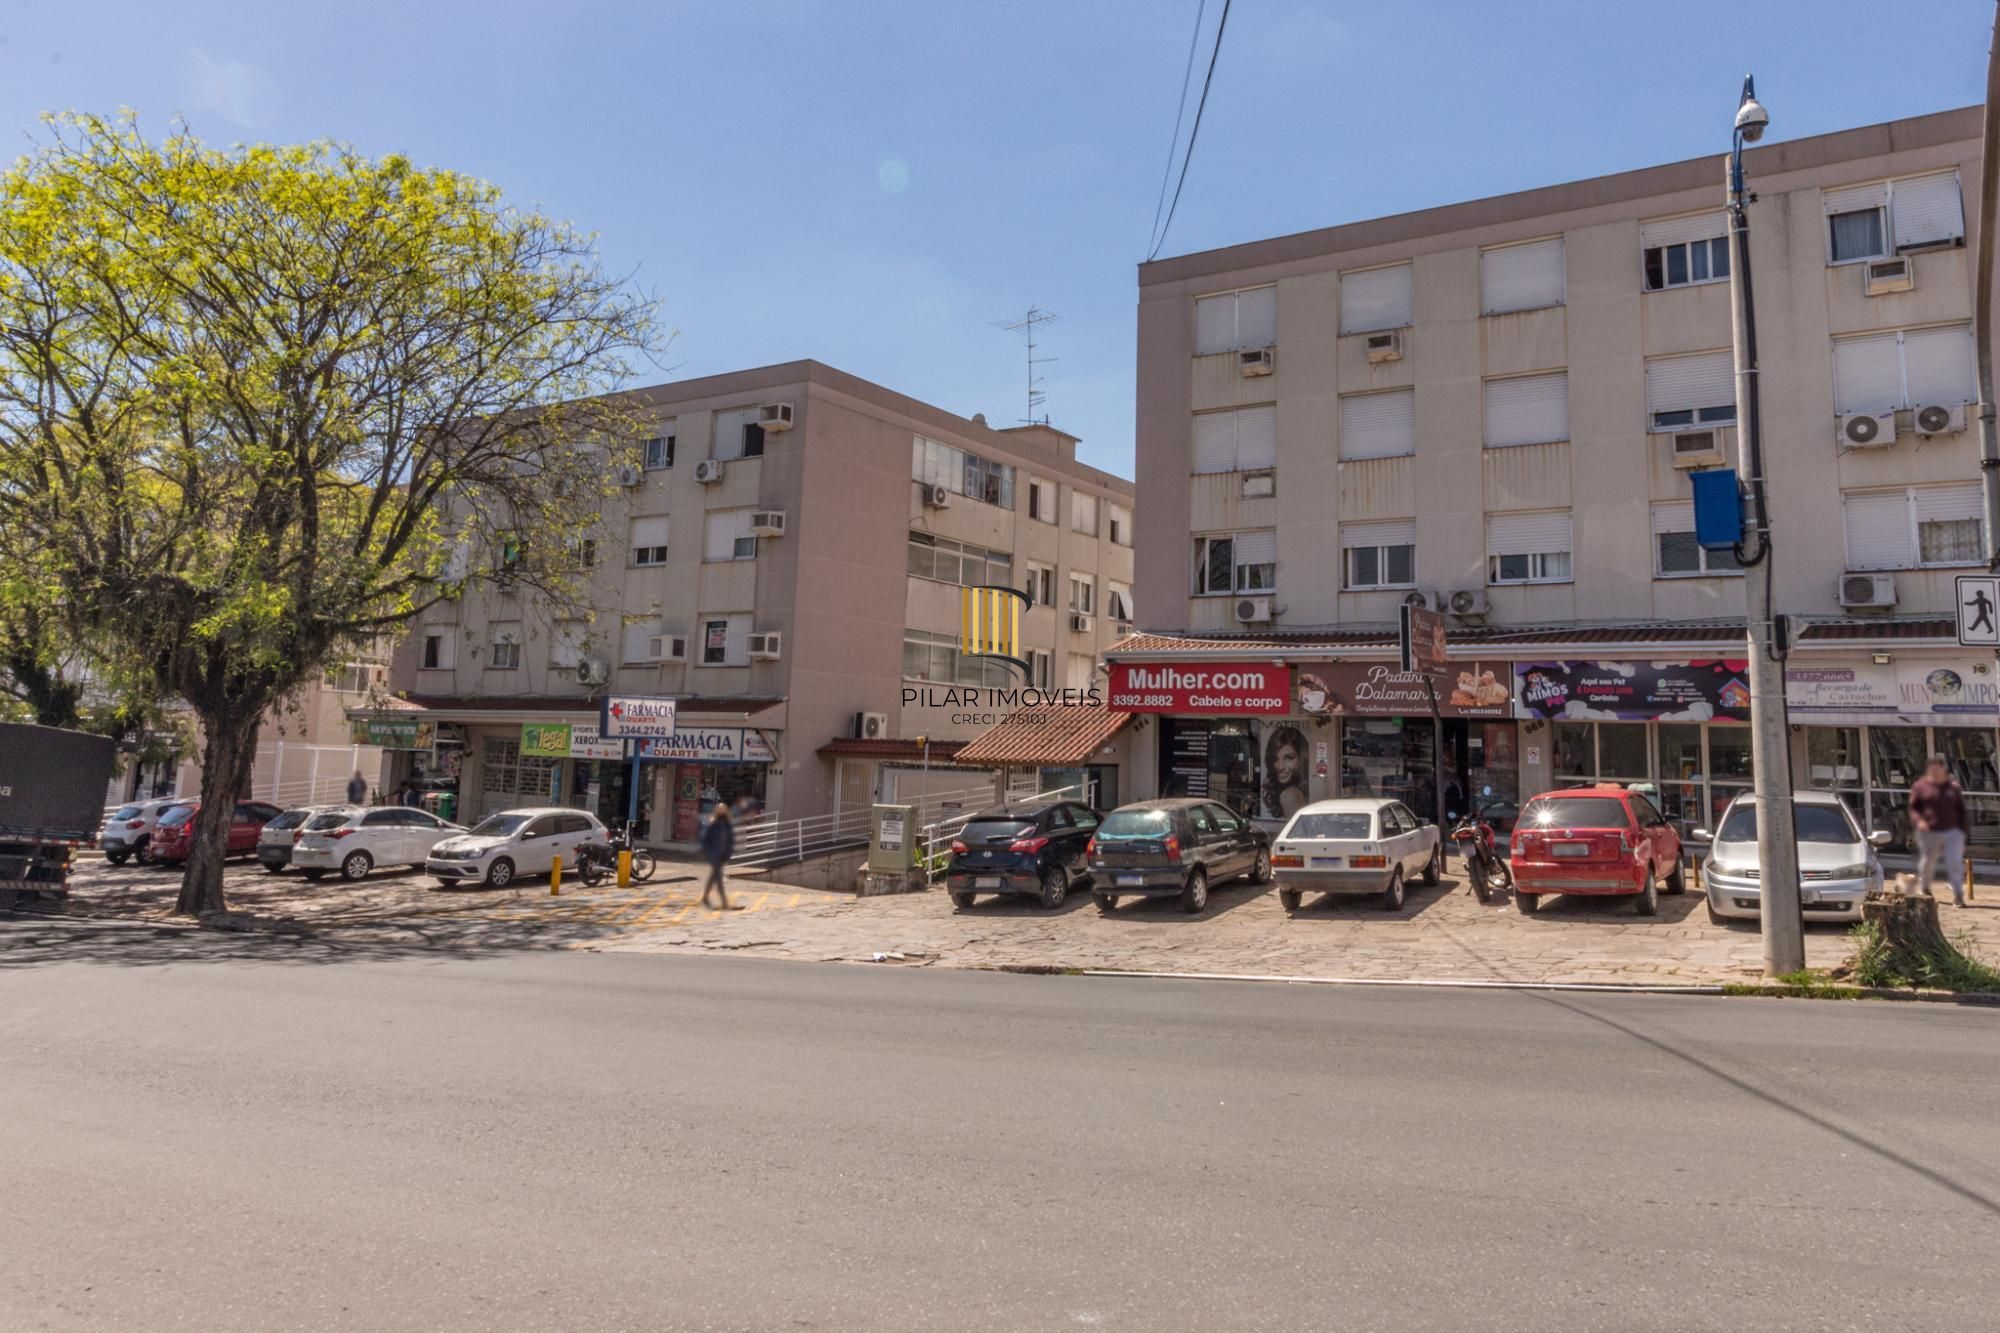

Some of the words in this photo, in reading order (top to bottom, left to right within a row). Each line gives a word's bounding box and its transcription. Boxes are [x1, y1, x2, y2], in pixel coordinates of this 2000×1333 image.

[1128, 667, 1265, 690] Mulher.com
[1367, 665, 1434, 684] Padari
[1527, 684, 1569, 702] MIMOS
[1859, 682, 1873, 692] de
[627, 701, 675, 718] FARMÁCIA
[1112, 694, 1174, 707] 3392.8882
[1188, 694, 1232, 707] Cabelo
[1234, 696, 1243, 707] e
[1244, 696, 1283, 710] corpo
[626, 716, 657, 724] DUARTE
[618, 725, 667, 737] 3344.2742
[573, 735, 600, 745] XEROX
[654, 730, 733, 751] FARMÁCIA
[653, 748, 700, 758] DUARTE
